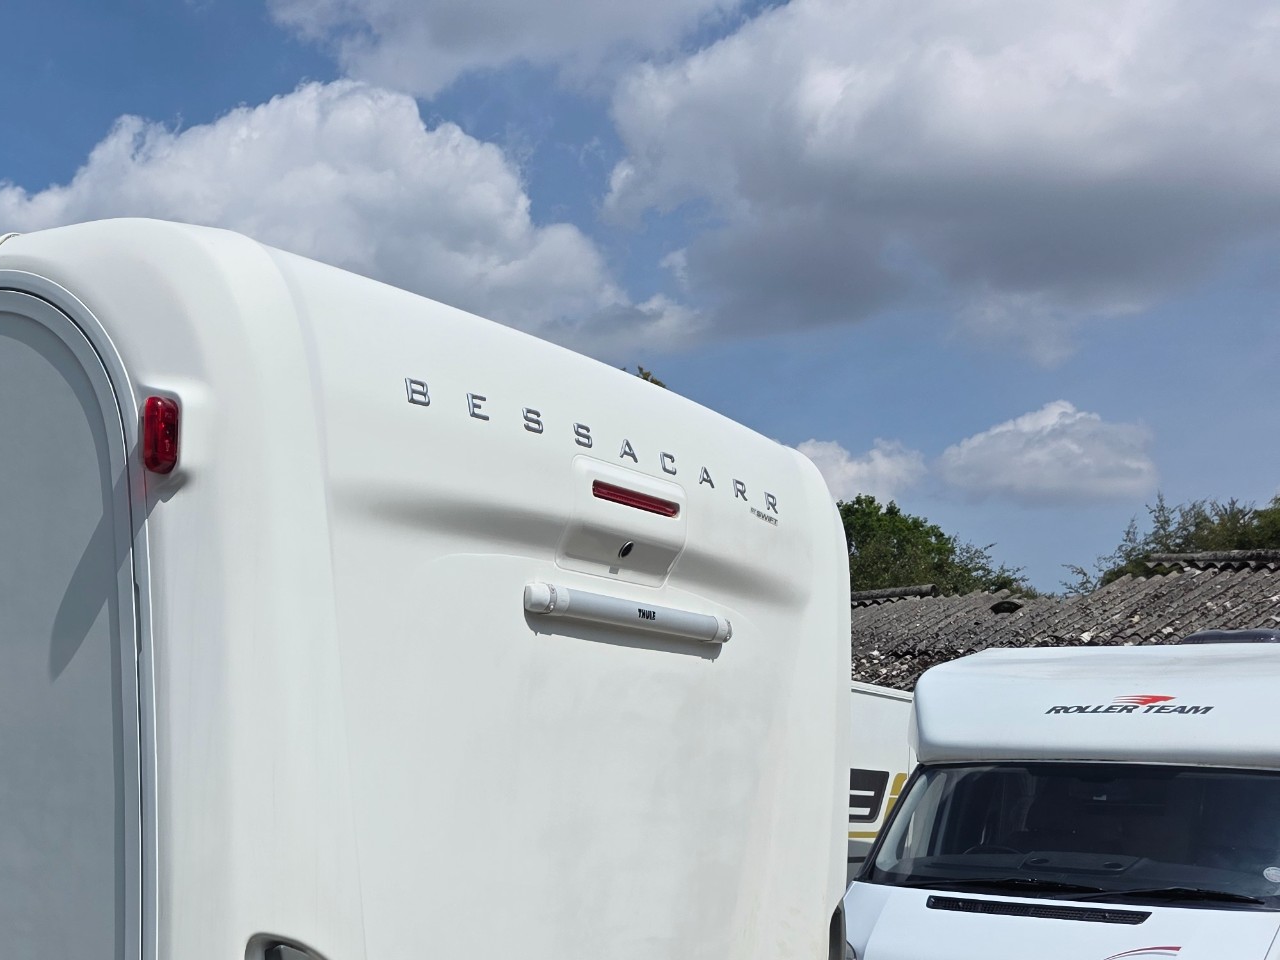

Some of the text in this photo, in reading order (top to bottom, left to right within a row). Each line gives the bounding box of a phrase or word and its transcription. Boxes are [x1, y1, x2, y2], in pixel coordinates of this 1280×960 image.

[404, 377, 778, 514] BESSACARR
[756, 510, 778, 525] SWIFT
[638, 608, 656, 620] THULE
[1045, 704, 1215, 715] ROLLER TEAM
